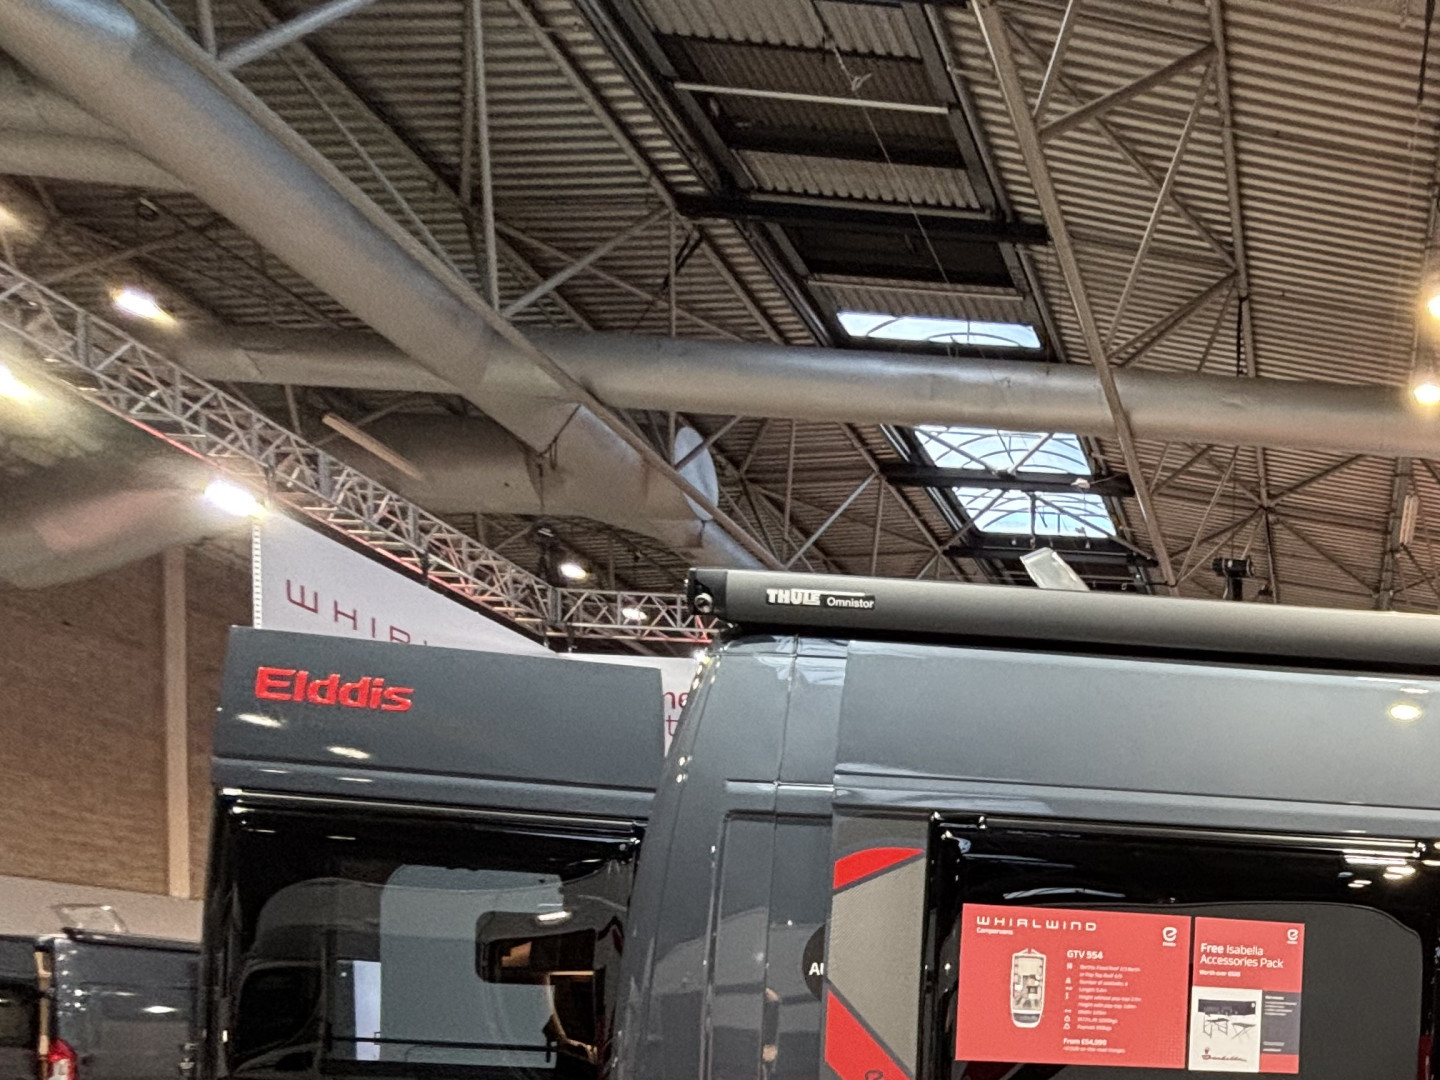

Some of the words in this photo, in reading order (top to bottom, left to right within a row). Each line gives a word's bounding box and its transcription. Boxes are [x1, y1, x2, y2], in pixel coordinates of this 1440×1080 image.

[766, 588, 821, 606] THULE
[826, 596, 875, 609] Omnistor
[286, 579, 427, 646] WHIR
[255, 666, 415, 712] Elddis
[976, 916, 1097, 931] WHIRLWIND
[1066, 950, 1085, 959] GTV
[1200, 943, 1224, 954] Free
[1226, 945, 1263, 956] Isabella
[1200, 954, 1258, 967] Accessories
[1260, 958, 1284, 968] Pack
